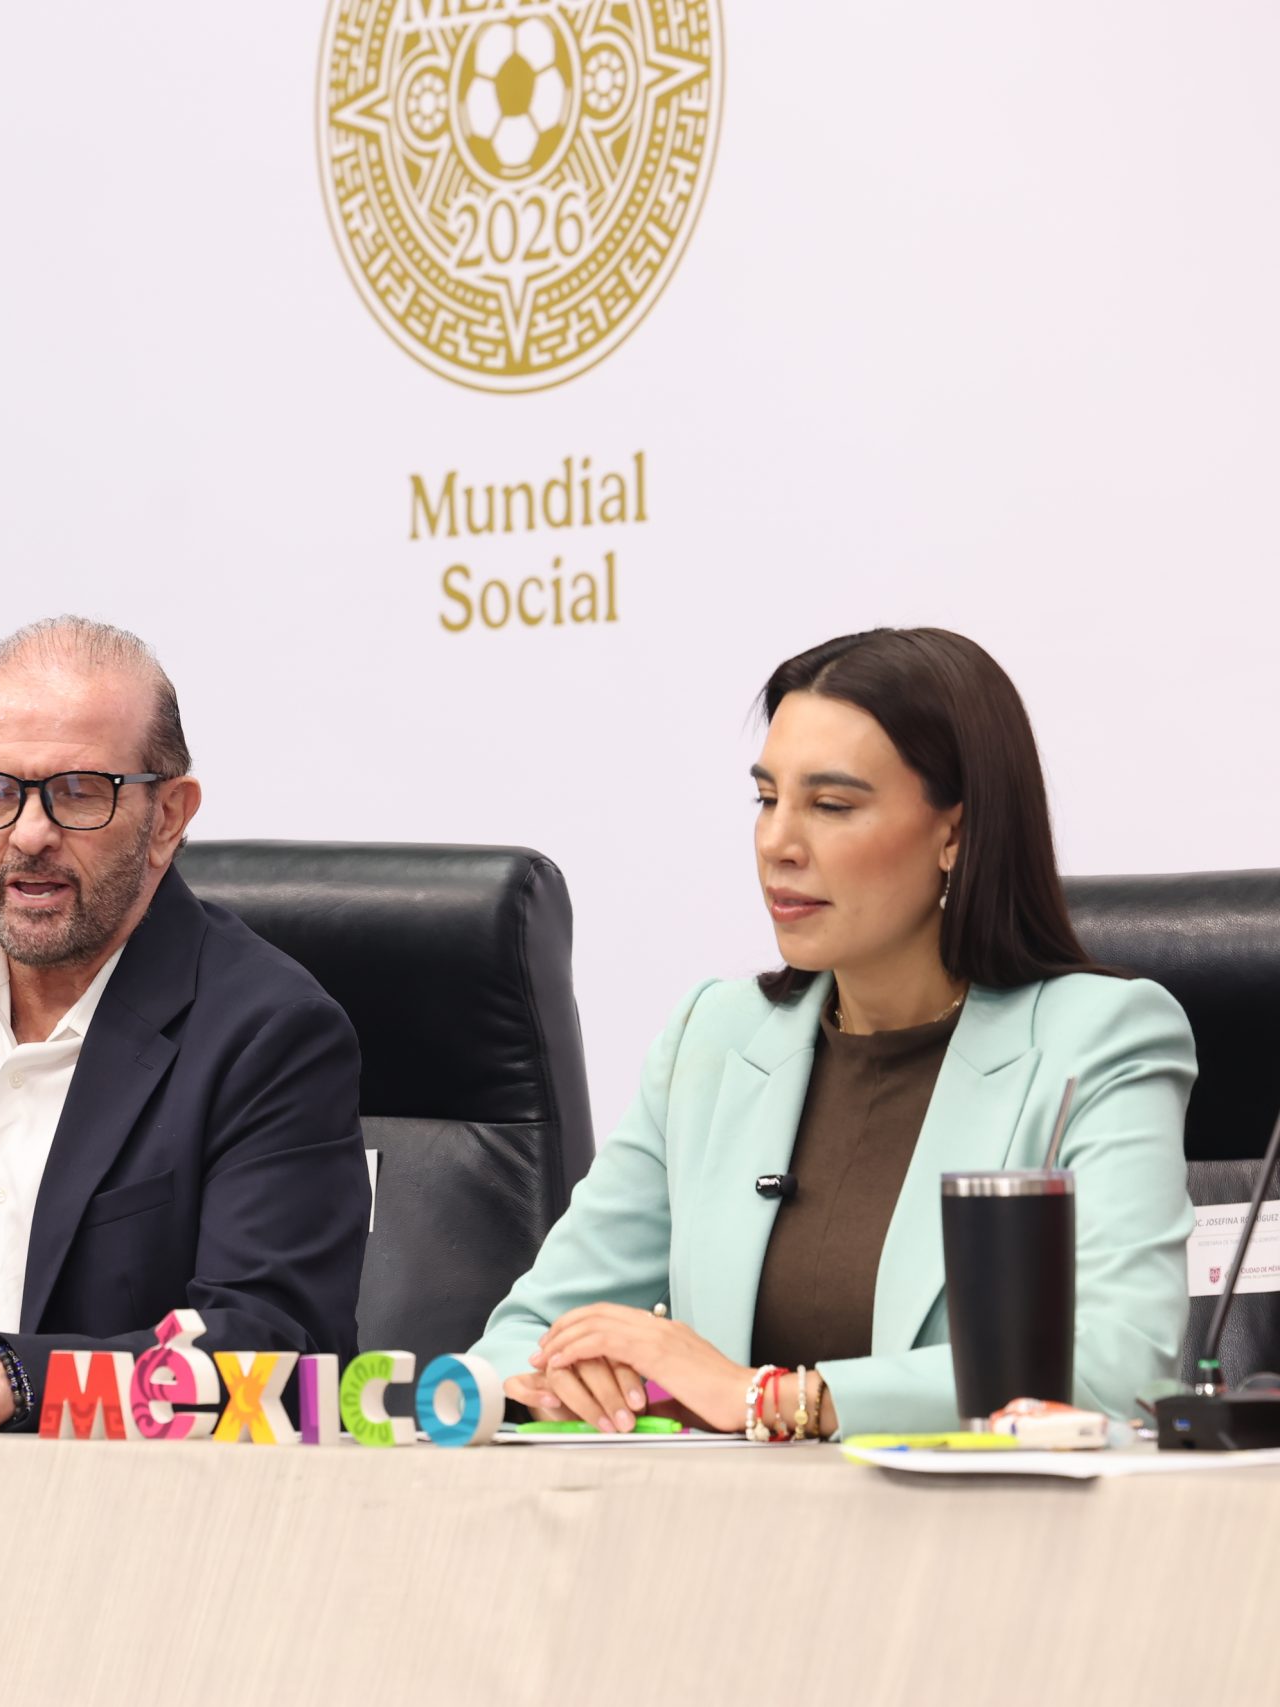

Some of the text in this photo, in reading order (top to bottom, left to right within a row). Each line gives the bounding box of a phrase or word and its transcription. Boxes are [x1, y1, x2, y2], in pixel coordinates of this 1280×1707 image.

[455, 190, 584, 269] 2026
[408, 450, 649, 540] Mundial
[439, 550, 619, 633] Social
[1205, 1216, 1239, 1227] JOSEFINA
